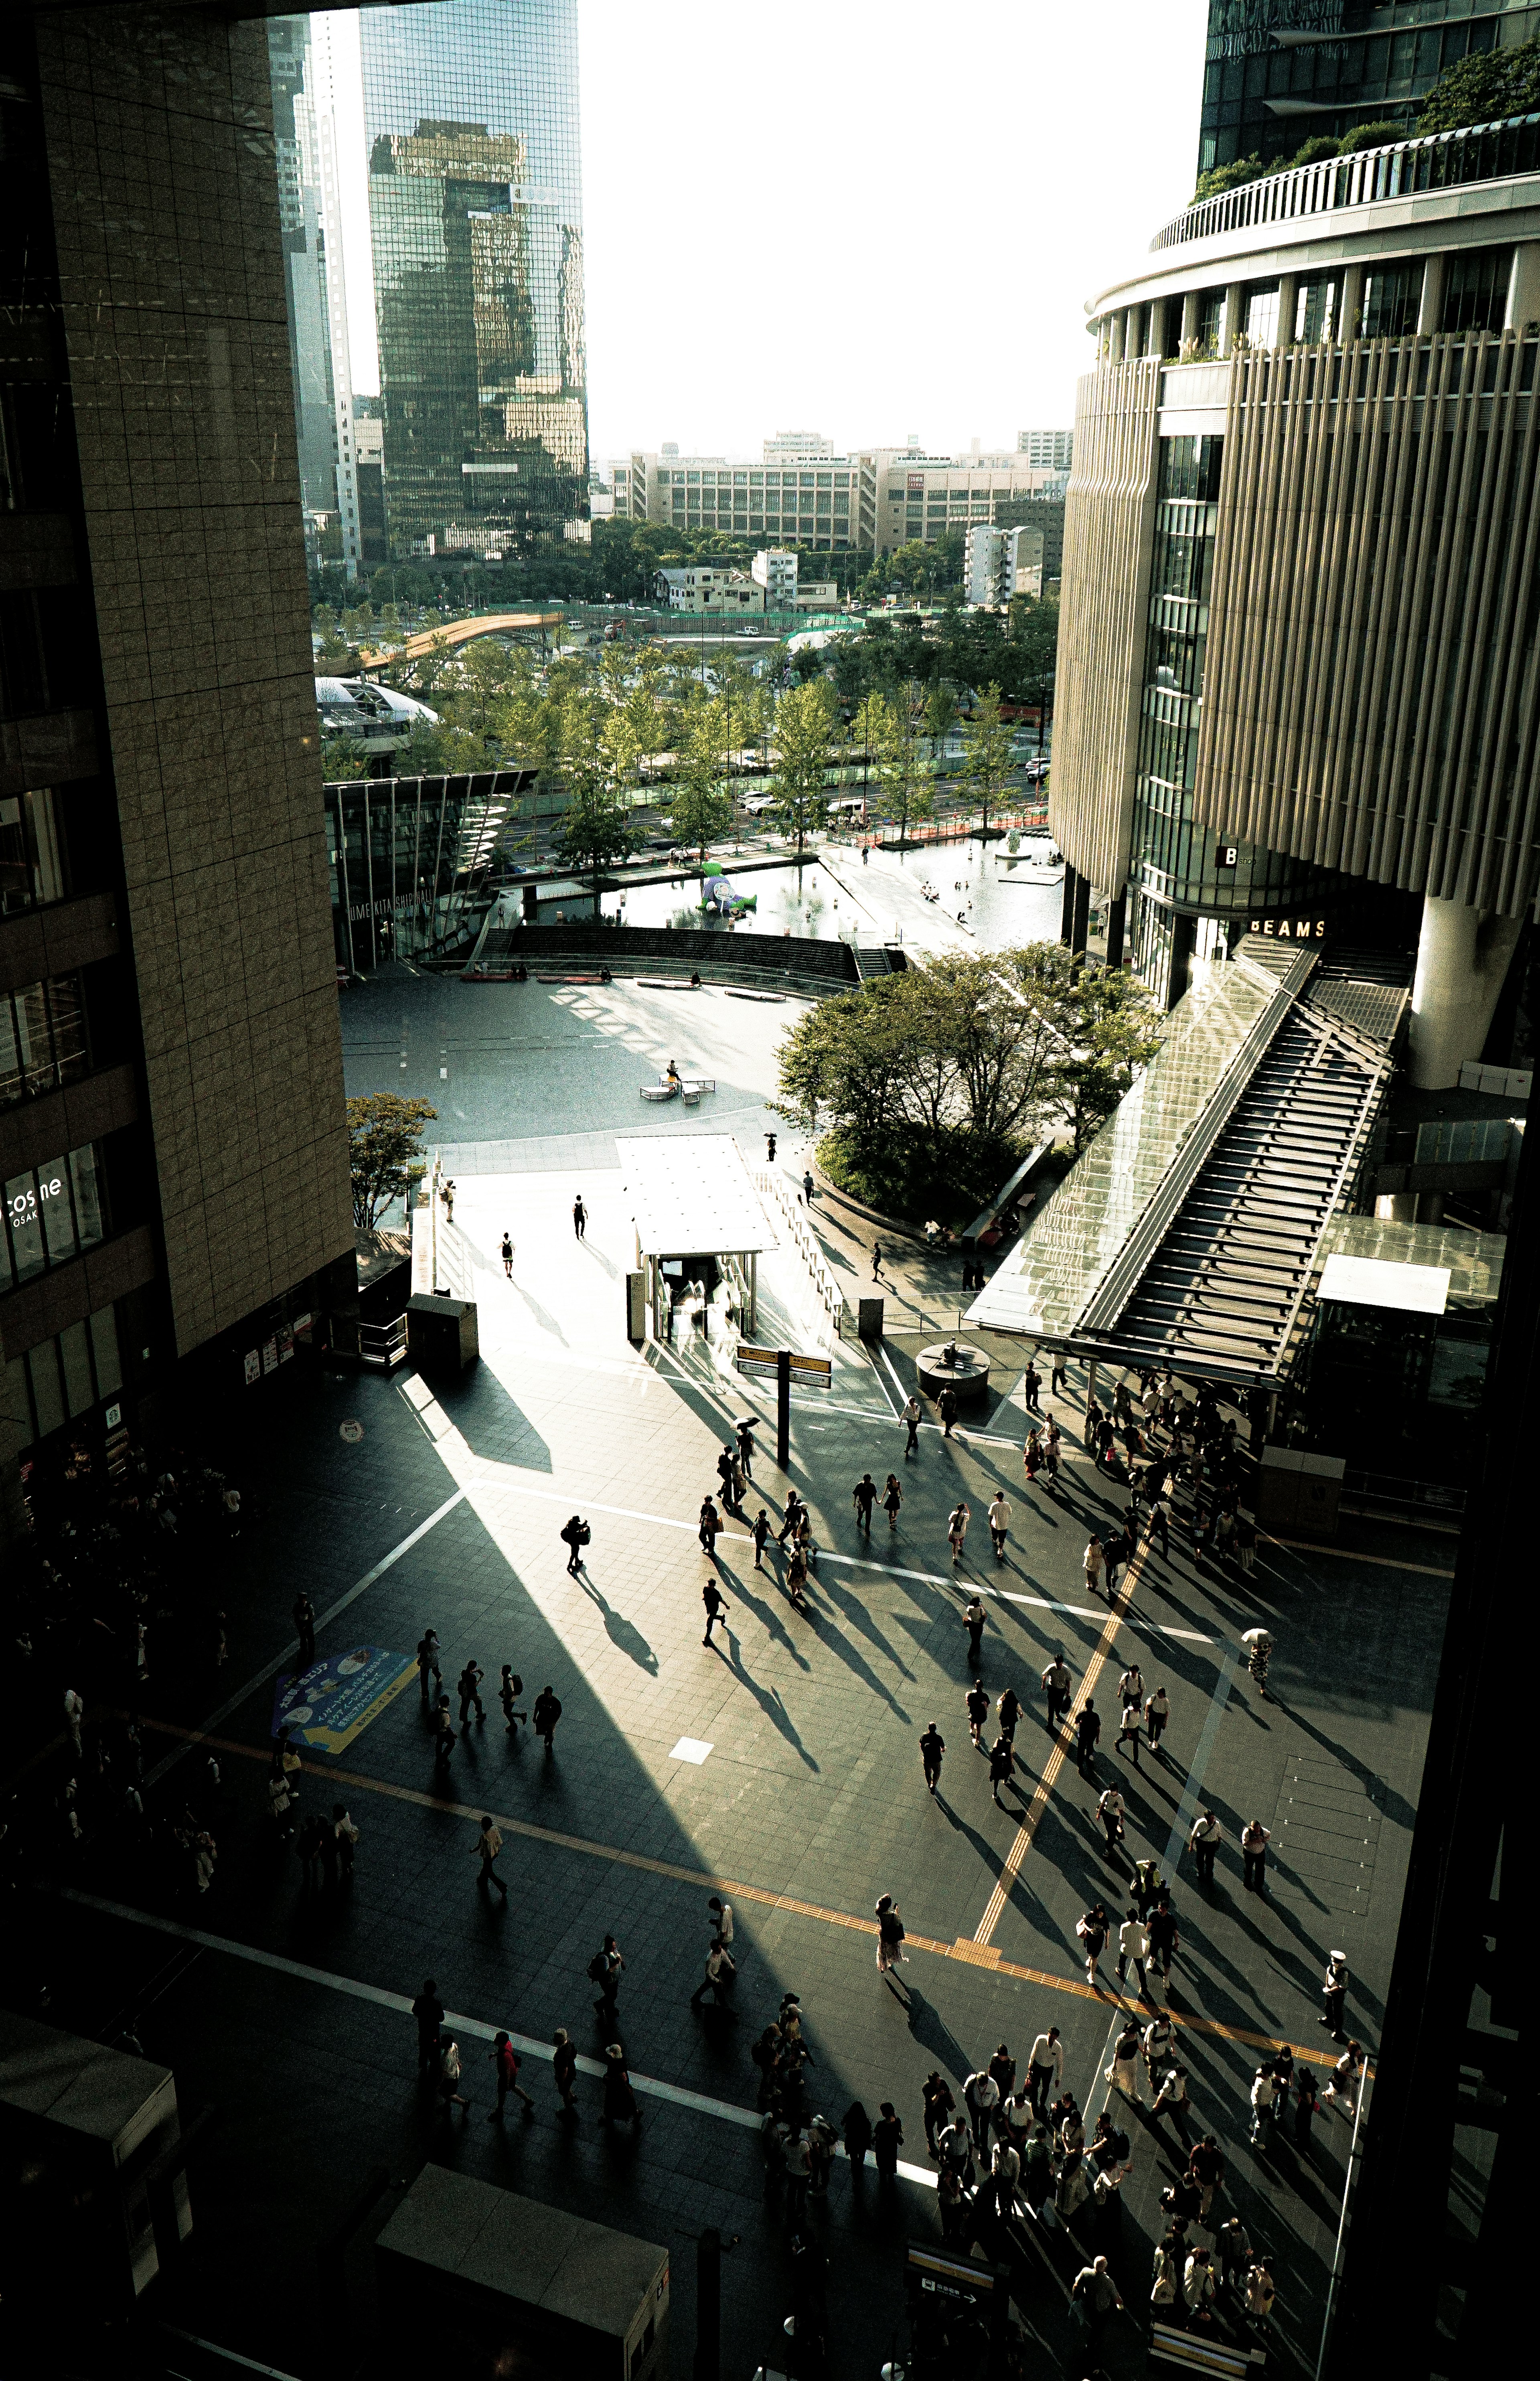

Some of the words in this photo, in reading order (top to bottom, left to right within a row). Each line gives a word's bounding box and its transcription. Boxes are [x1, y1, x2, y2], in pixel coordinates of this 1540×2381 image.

[1226, 848, 1237, 864] B
[396, 893, 413, 910] SHIP
[1251, 920, 1325, 937] BEAMS
